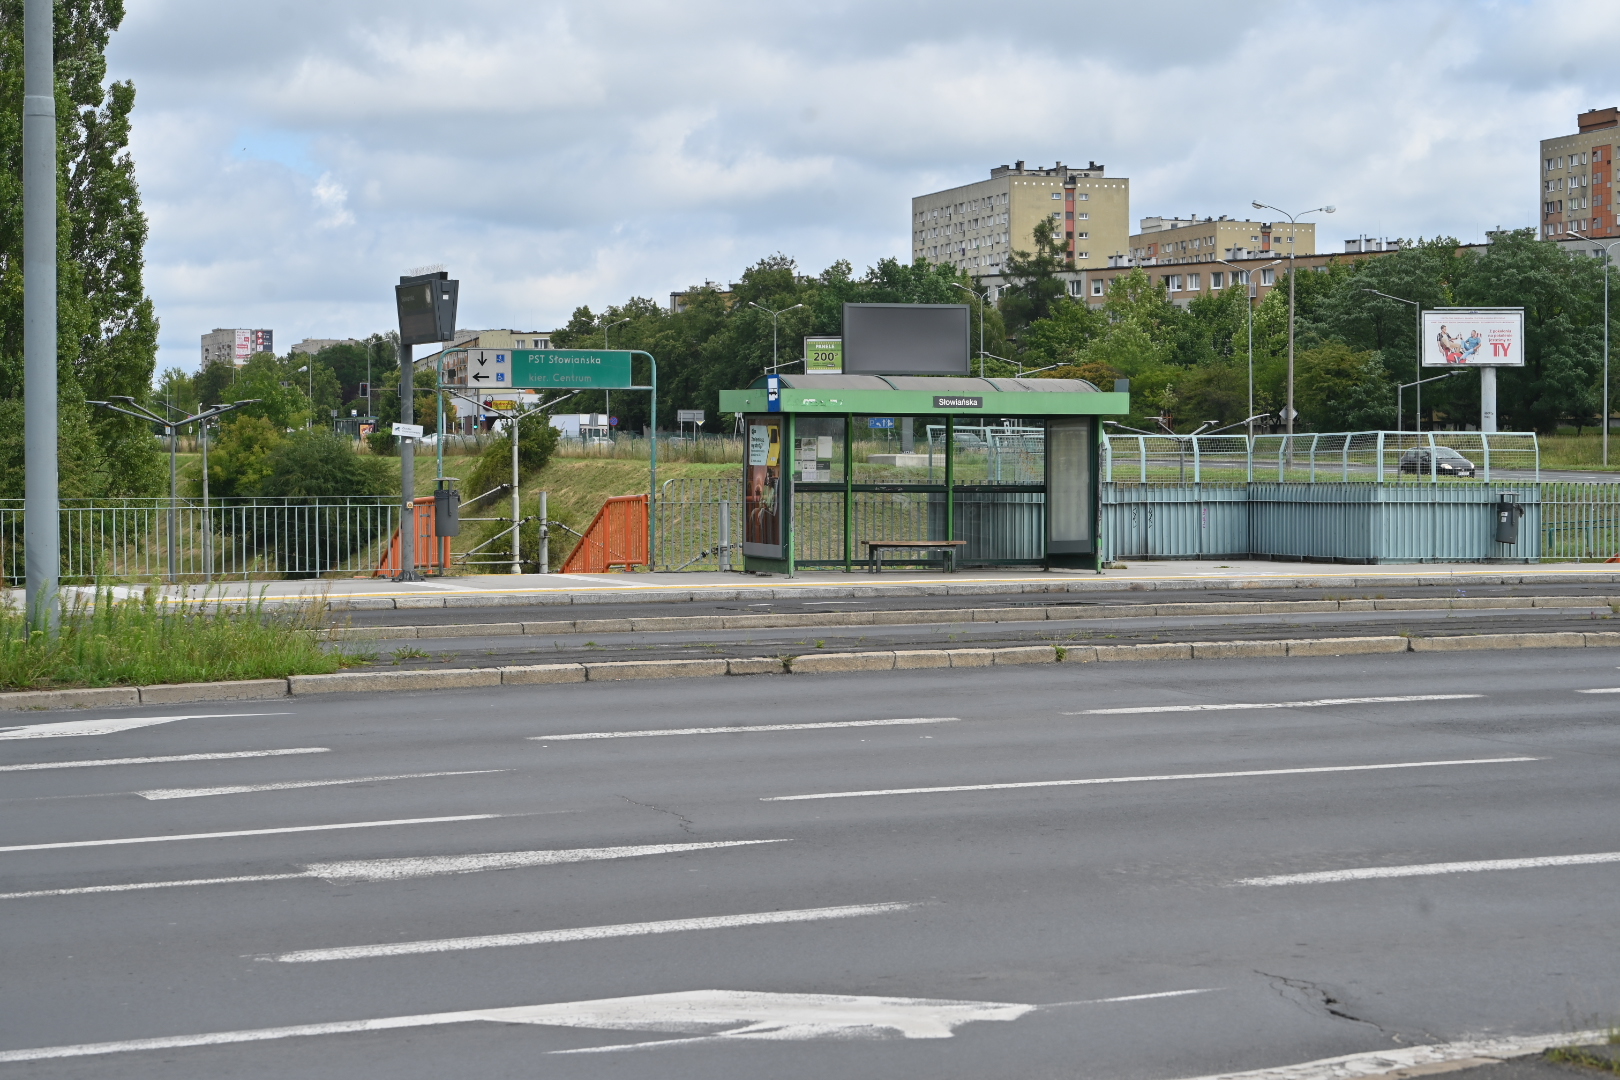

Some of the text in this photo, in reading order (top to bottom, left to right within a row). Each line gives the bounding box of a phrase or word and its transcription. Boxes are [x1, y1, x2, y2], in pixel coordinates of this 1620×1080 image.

[528, 355, 601, 364] PST Słowiańska
[814, 352, 834, 361] 200
[529, 373, 592, 382] kier. Centrum
